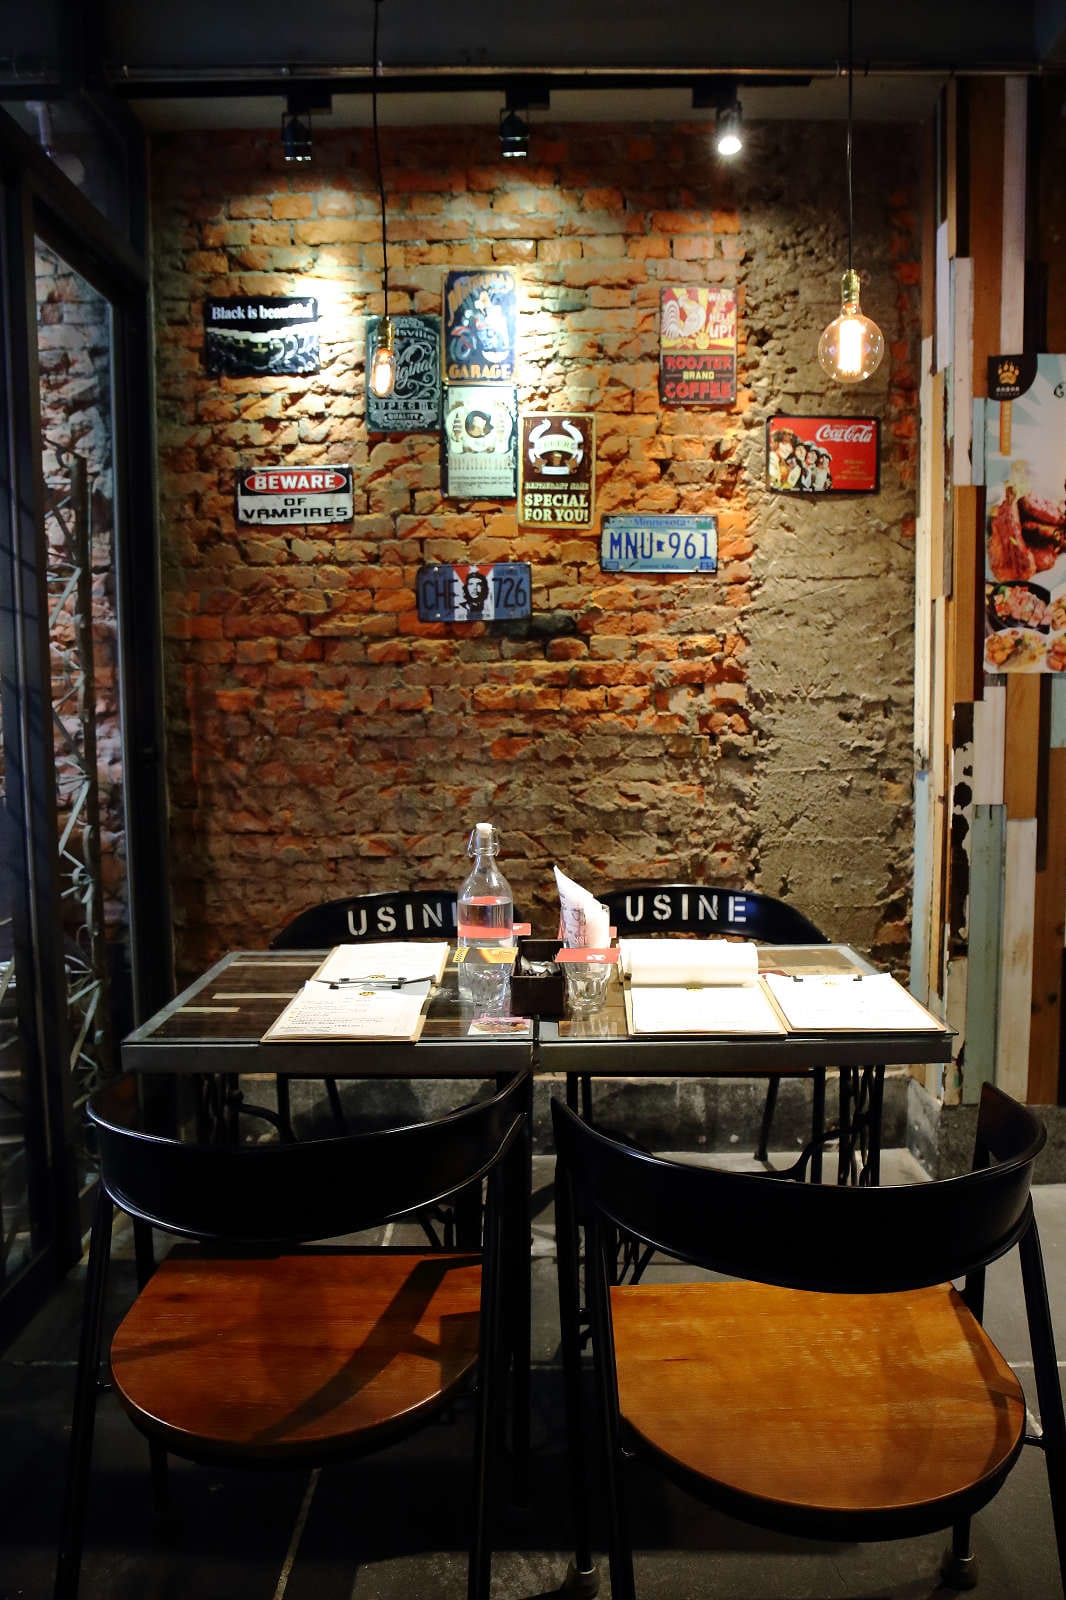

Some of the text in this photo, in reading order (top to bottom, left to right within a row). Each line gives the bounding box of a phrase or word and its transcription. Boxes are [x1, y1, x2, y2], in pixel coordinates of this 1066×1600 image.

[212, 306, 246, 320] Black
[247, 305, 258, 320] is
[665, 355, 732, 370] ROOSTER
[449, 363, 512, 379] GARAGE
[682, 371, 715, 381] BRAND
[664, 382, 732, 398] COFFEE
[816, 423, 873, 443] Coca-Cola
[254, 475, 336, 490] BEWARE
[284, 497, 308, 507] OF
[524, 493, 589, 508] SPECIAL
[242, 507, 348, 520] VAMPIRES
[525, 508, 589, 522] FOR YOU!
[610, 532, 712, 560] MNU 961
[422, 577, 527, 611] CHE 726
[625, 894, 747, 922] USINE
